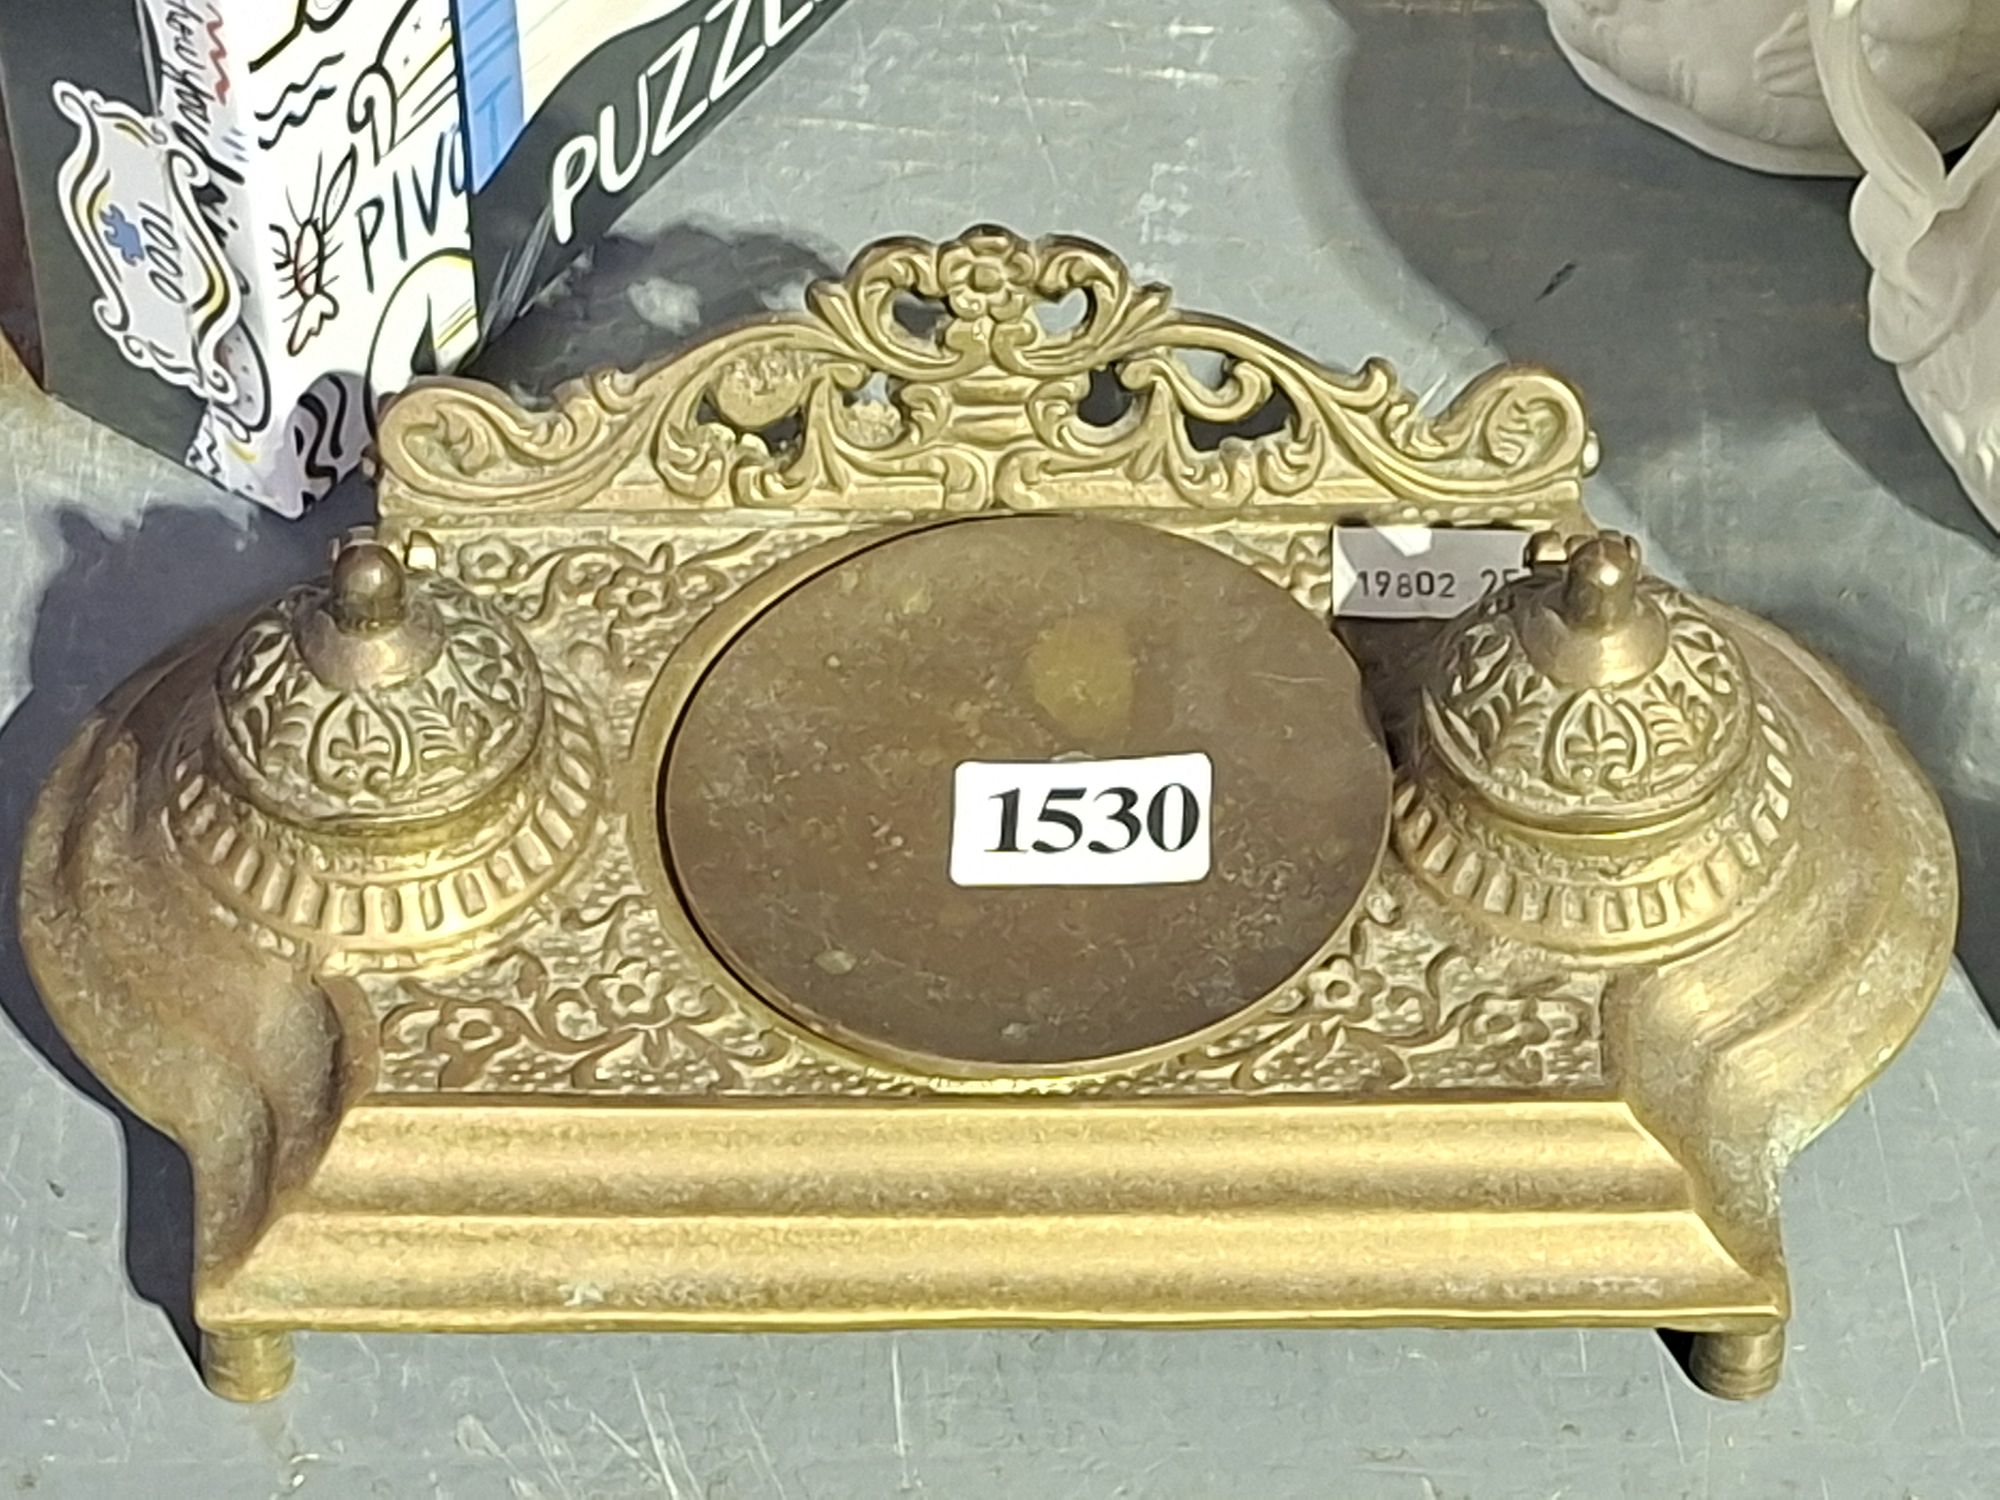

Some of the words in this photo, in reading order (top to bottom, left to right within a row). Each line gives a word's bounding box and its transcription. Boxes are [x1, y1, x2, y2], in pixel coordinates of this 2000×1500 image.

[551, 0, 824, 244] PUZZL
[138, 201, 188, 304] 1000
[1356, 570, 1456, 599] 19802
[984, 782, 1200, 855] 1530
